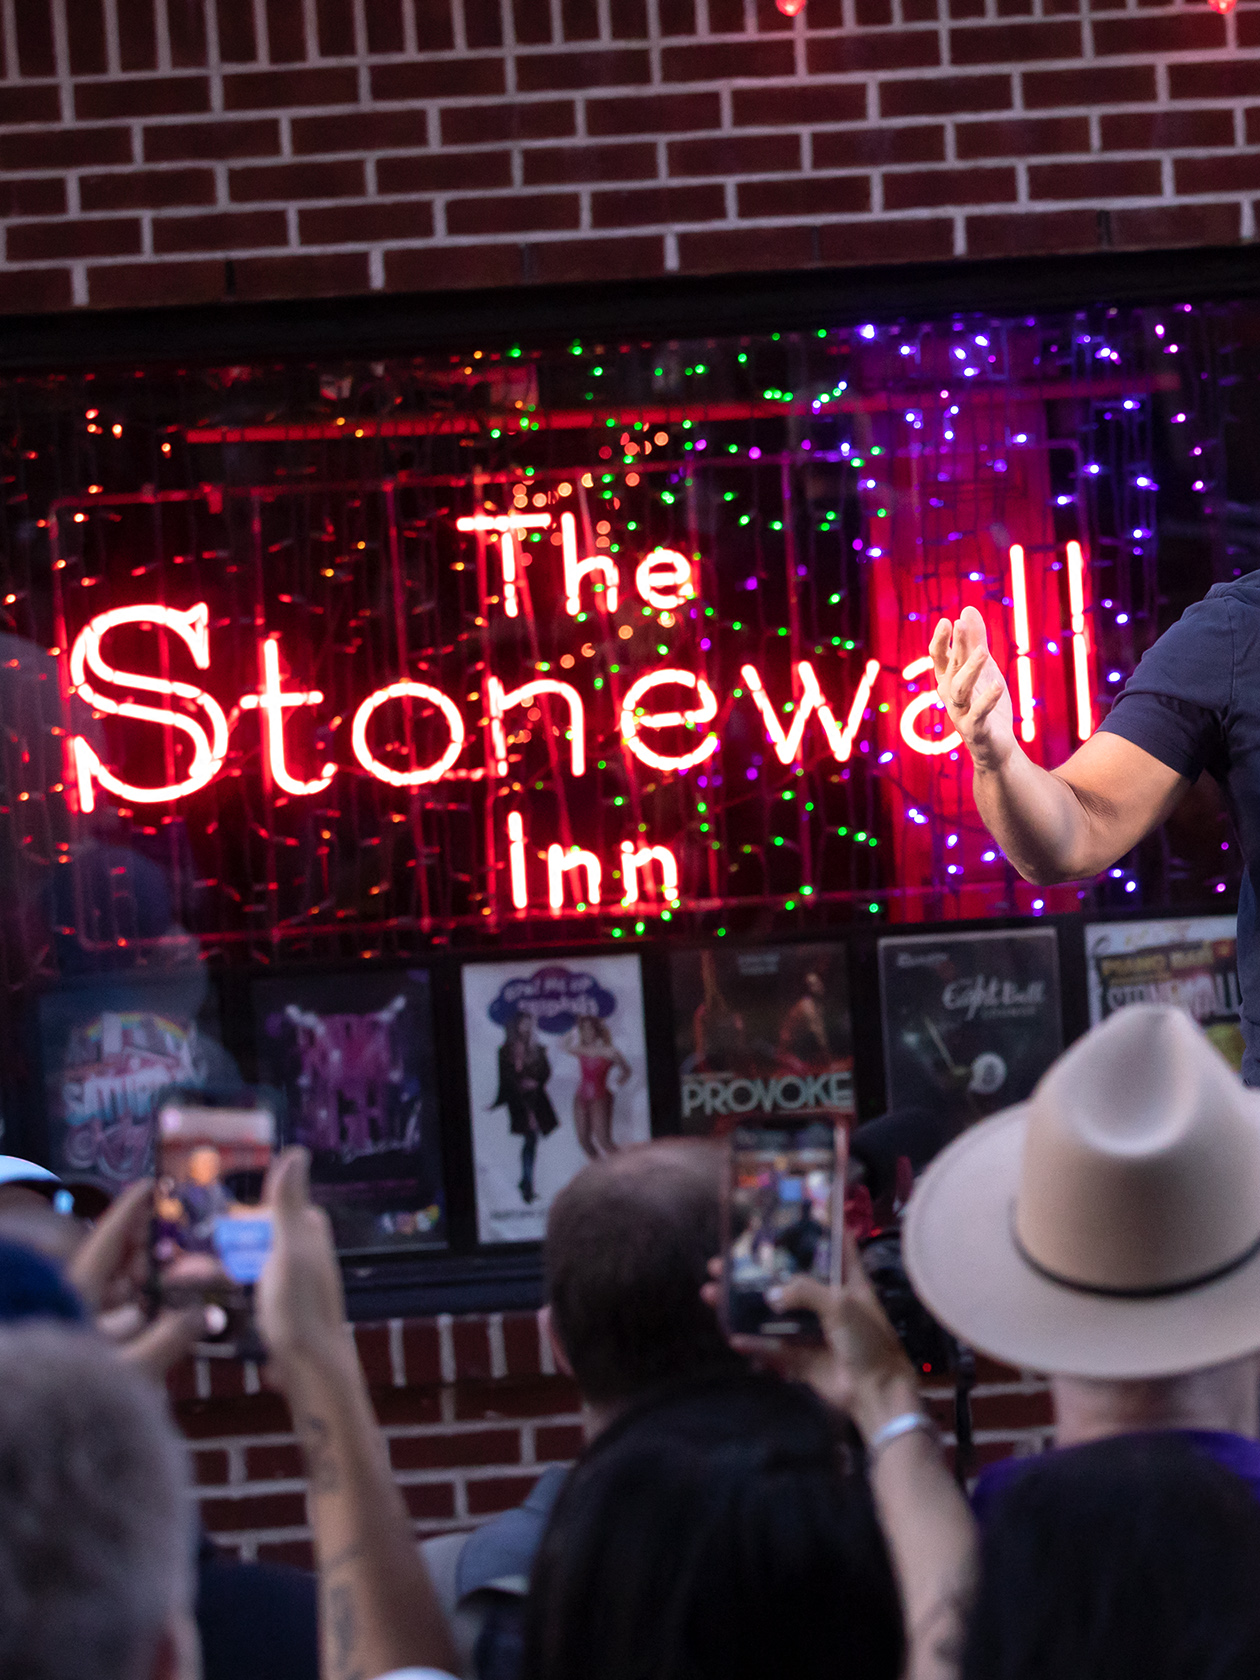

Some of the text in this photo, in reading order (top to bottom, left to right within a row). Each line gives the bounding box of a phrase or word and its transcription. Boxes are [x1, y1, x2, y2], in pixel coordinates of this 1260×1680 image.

[456, 511, 693, 618] The
[70, 541, 1093, 812] Stonewall
[507, 811, 678, 909] Inn
[681, 1071, 853, 1118] PROVOKE
